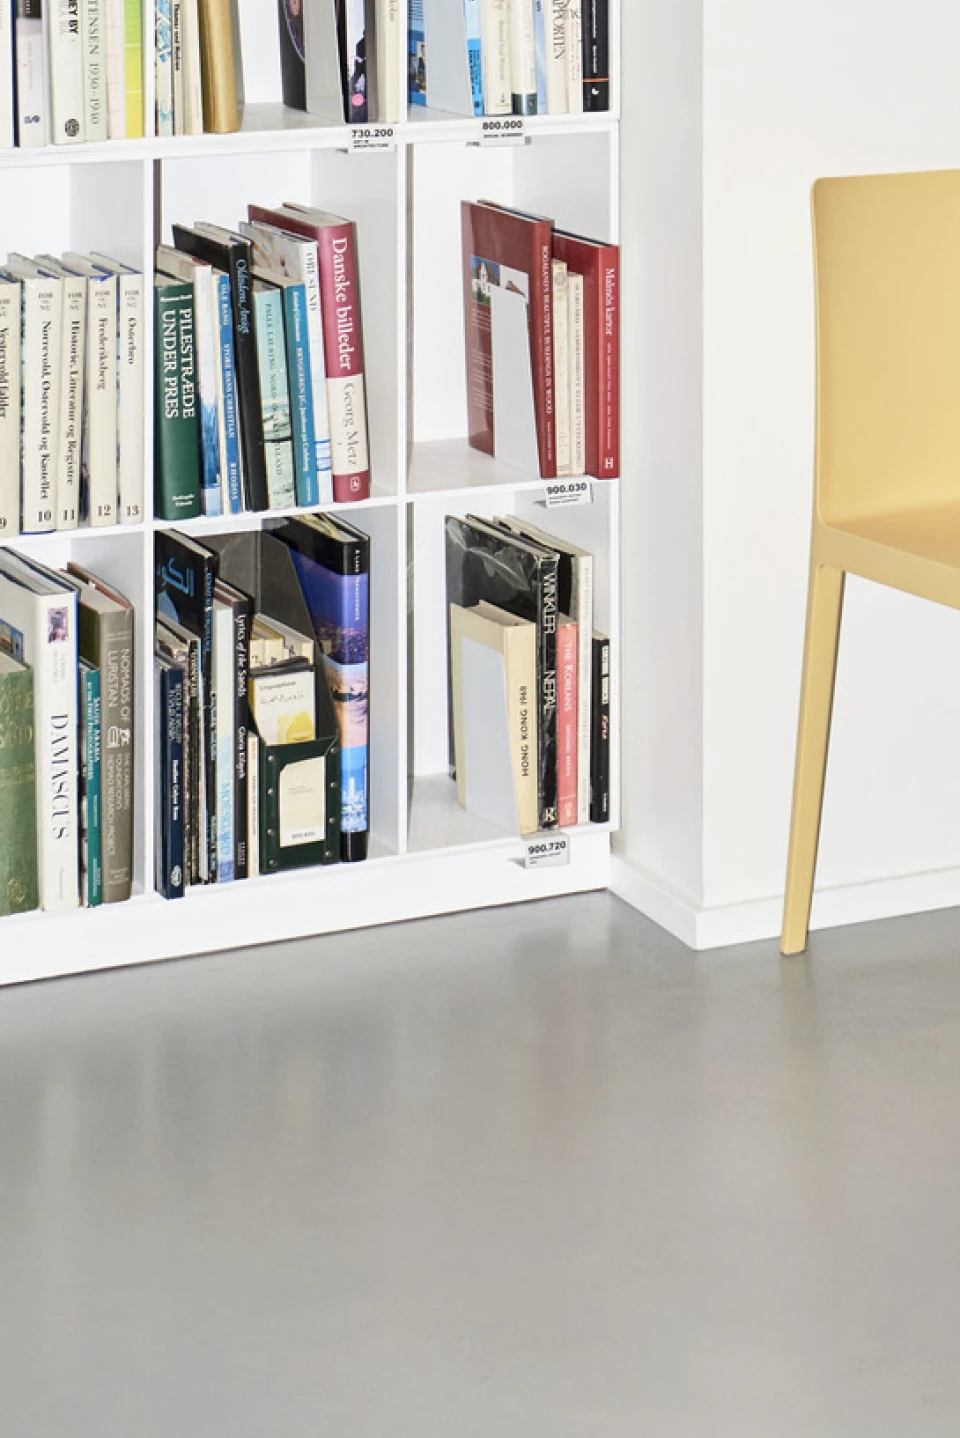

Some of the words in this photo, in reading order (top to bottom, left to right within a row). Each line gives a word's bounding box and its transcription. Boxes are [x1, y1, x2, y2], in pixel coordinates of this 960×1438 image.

[68, 19, 78, 35] BY
[352, 128, 393, 139] 730.200
[483, 120, 523, 130] 800.000
[330, 237, 349, 304] Danske
[69, 320, 81, 369] Historie,
[96, 317, 109, 391] Frederiksberg
[127, 316, 138, 365] Østerbro
[161, 309, 178, 373] UNDER
[335, 306, 356, 372] billeder
[179, 307, 195, 420] PILESTRÆDE
[67, 370, 80, 423] Litteratur
[163, 375, 180, 420] PRES
[340, 382, 359, 429] Georg
[65, 424, 76, 439] og
[226, 393, 236, 439] CHRISTIAN
[38, 436, 48, 451] og
[346, 430, 362, 467] Metz
[39, 452, 50, 500] Kastellet
[65, 440, 77, 487] Registre
[547, 482, 587, 494] 900.030
[38, 510, 52, 523] 10
[62, 508, 76, 521] 11
[97, 505, 112, 517] 12
[126, 504, 140, 517] 13
[543, 572, 557, 634] WINKLER
[236, 613, 248, 641] Lyrics
[236, 641, 248, 653] of
[237, 653, 247, 668] the
[107, 650, 120, 708] LURISTAN
[120, 648, 131, 705] NOMADS
[237, 669, 248, 699] Sands
[543, 669, 557, 715] NEPAL
[121, 706, 131, 723] OF
[519, 708, 528, 741] KONG
[49, 713, 70, 842] DAMASCUS
[519, 744, 529, 777] HONG
[528, 841, 566, 854] 900.720
